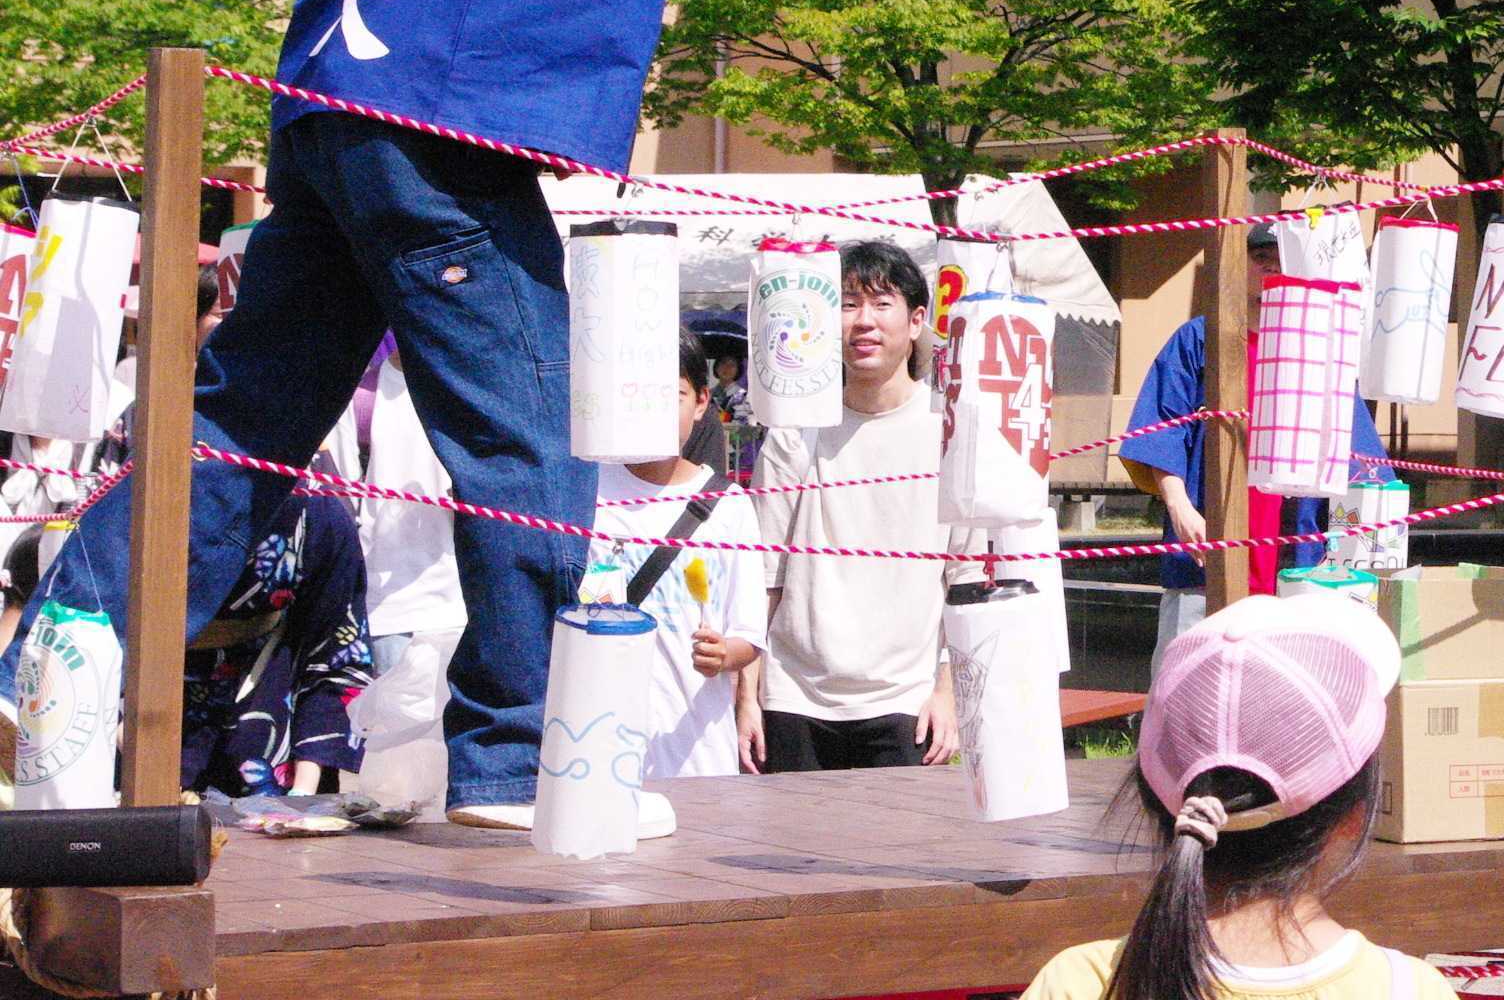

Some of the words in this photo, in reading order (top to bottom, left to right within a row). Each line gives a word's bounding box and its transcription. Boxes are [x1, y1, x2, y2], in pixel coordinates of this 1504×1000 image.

[758, 272, 839, 308] en-join
[30, 624, 86, 672] -join
[69, 841, 102, 851] DENON
